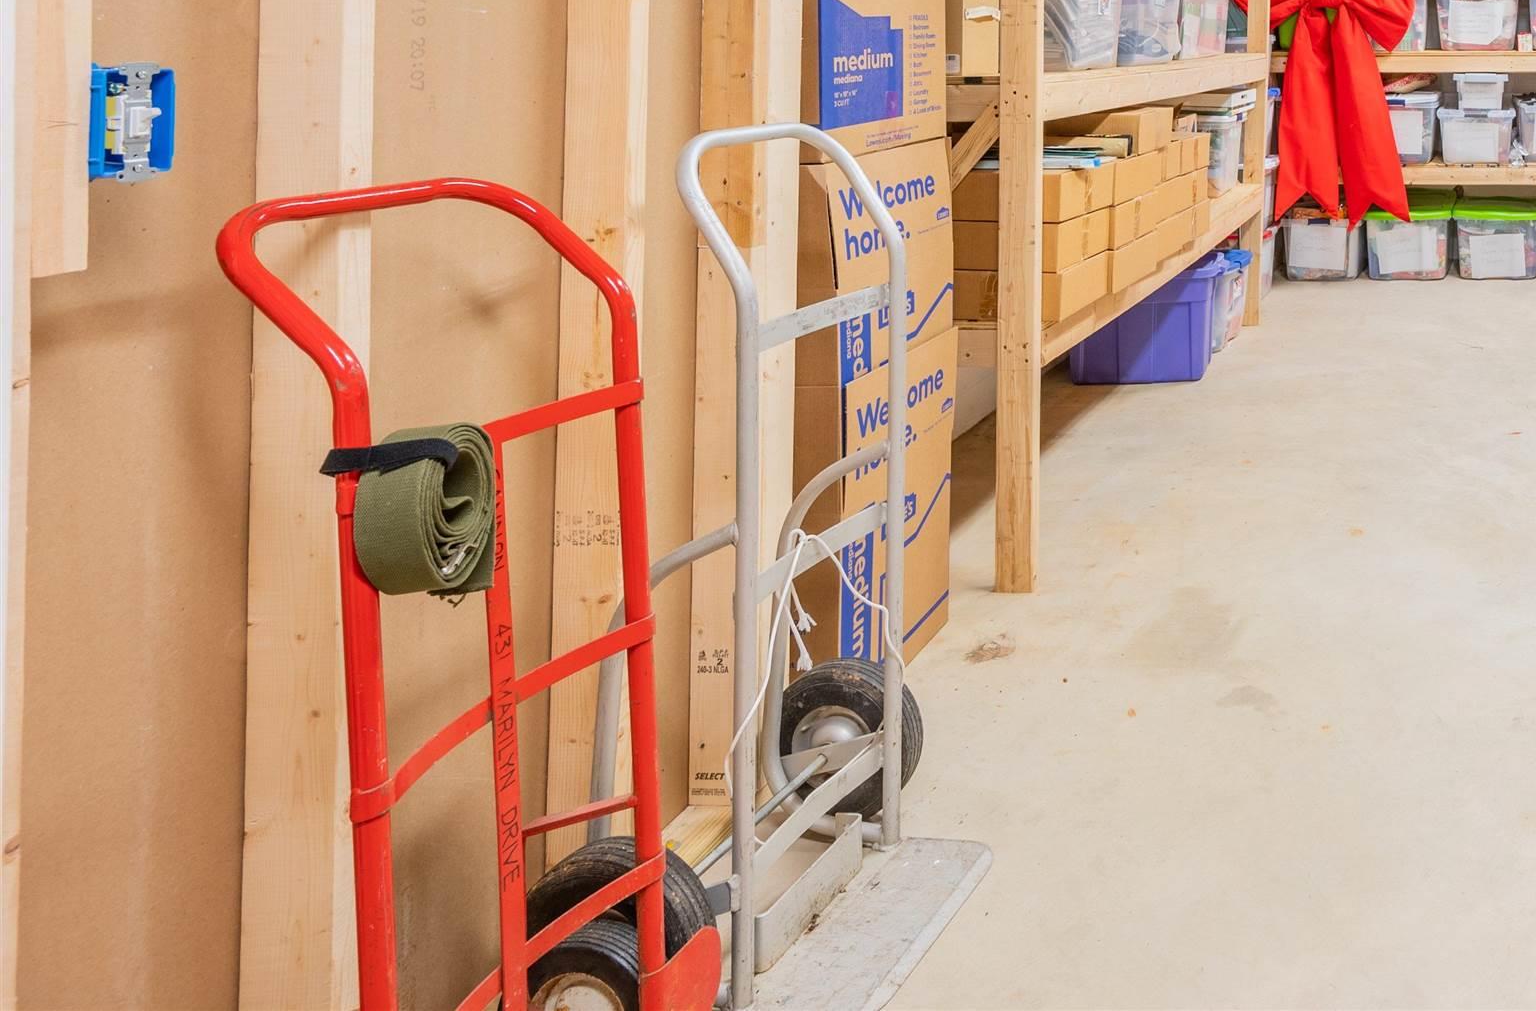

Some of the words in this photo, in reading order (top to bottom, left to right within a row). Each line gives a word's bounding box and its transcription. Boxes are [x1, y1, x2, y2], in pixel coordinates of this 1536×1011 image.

[410, 37, 425, 91] 20:07
[833, 48, 893, 72] medium
[833, 74, 863, 84] mediana
[838, 175, 935, 221] Wlcome
[856, 369, 944, 438] Weome
[495, 623, 512, 660] 431
[716, 658, 723, 666] 2
[498, 676, 516, 792] MARILYN
[695, 772, 725, 781] SELECT
[501, 805, 521, 893] DRIVE
